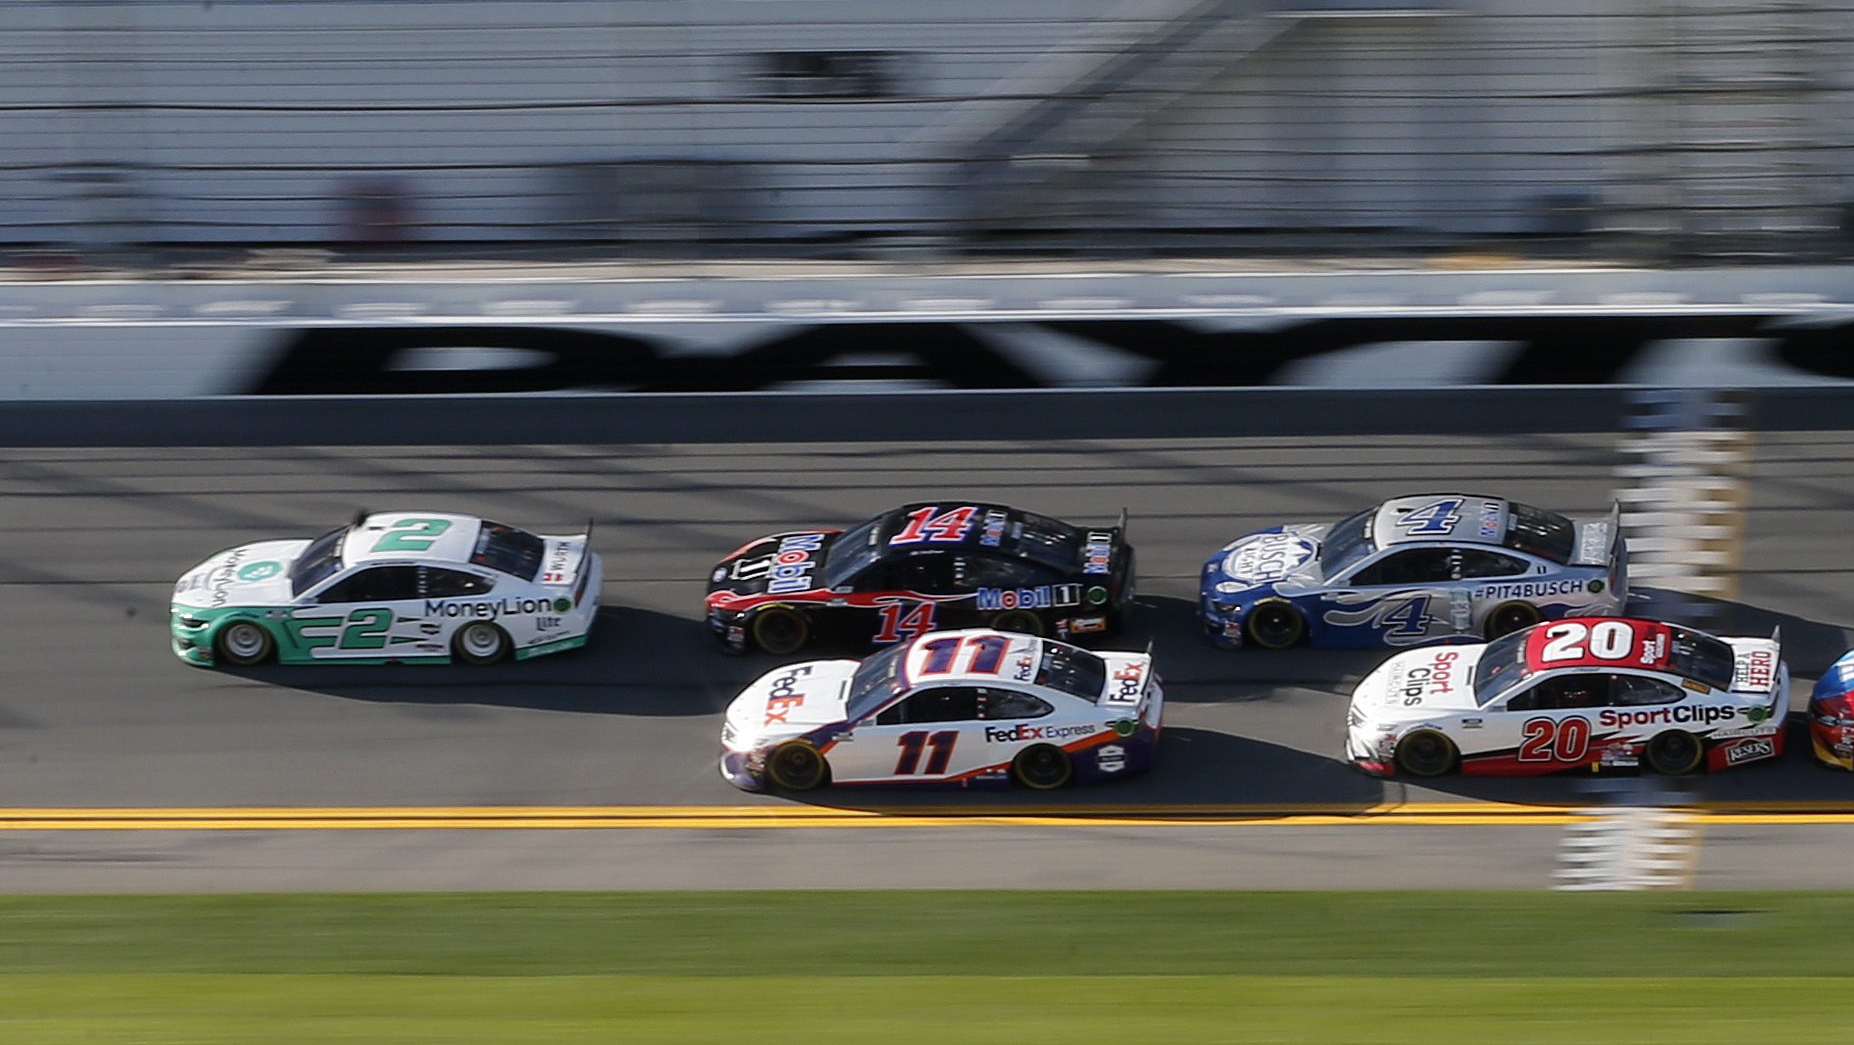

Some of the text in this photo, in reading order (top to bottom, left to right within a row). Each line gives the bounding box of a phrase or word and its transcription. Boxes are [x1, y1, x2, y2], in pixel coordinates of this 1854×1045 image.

[370, 519, 452, 552] 2
[889, 507, 976, 544] 14
[1397, 498, 1464, 535] 4
[768, 534, 825, 593] Mobil
[1252, 534, 1289, 582] BUSCH
[425, 597, 550, 621] MoneyLion
[976, 585, 1051, 610] Mobil
[1475, 581, 1582, 599] #PIT4BUSCH
[339, 607, 393, 649] 2
[872, 601, 937, 642] 14
[1382, 594, 1431, 635] 4
[919, 635, 1012, 676] 11
[1542, 621, 1634, 662] 20
[1109, 662, 1145, 703] FedEx
[1400, 668, 1431, 706] Clips
[1430, 652, 1458, 694] Sport
[1735, 661, 1750, 683] HELP
[1750, 651, 1772, 687] HERO
[764, 666, 812, 726] FedEx
[894, 730, 959, 775] 11
[985, 723, 1095, 742] FedEx Express
[1519, 716, 1591, 761] 20
